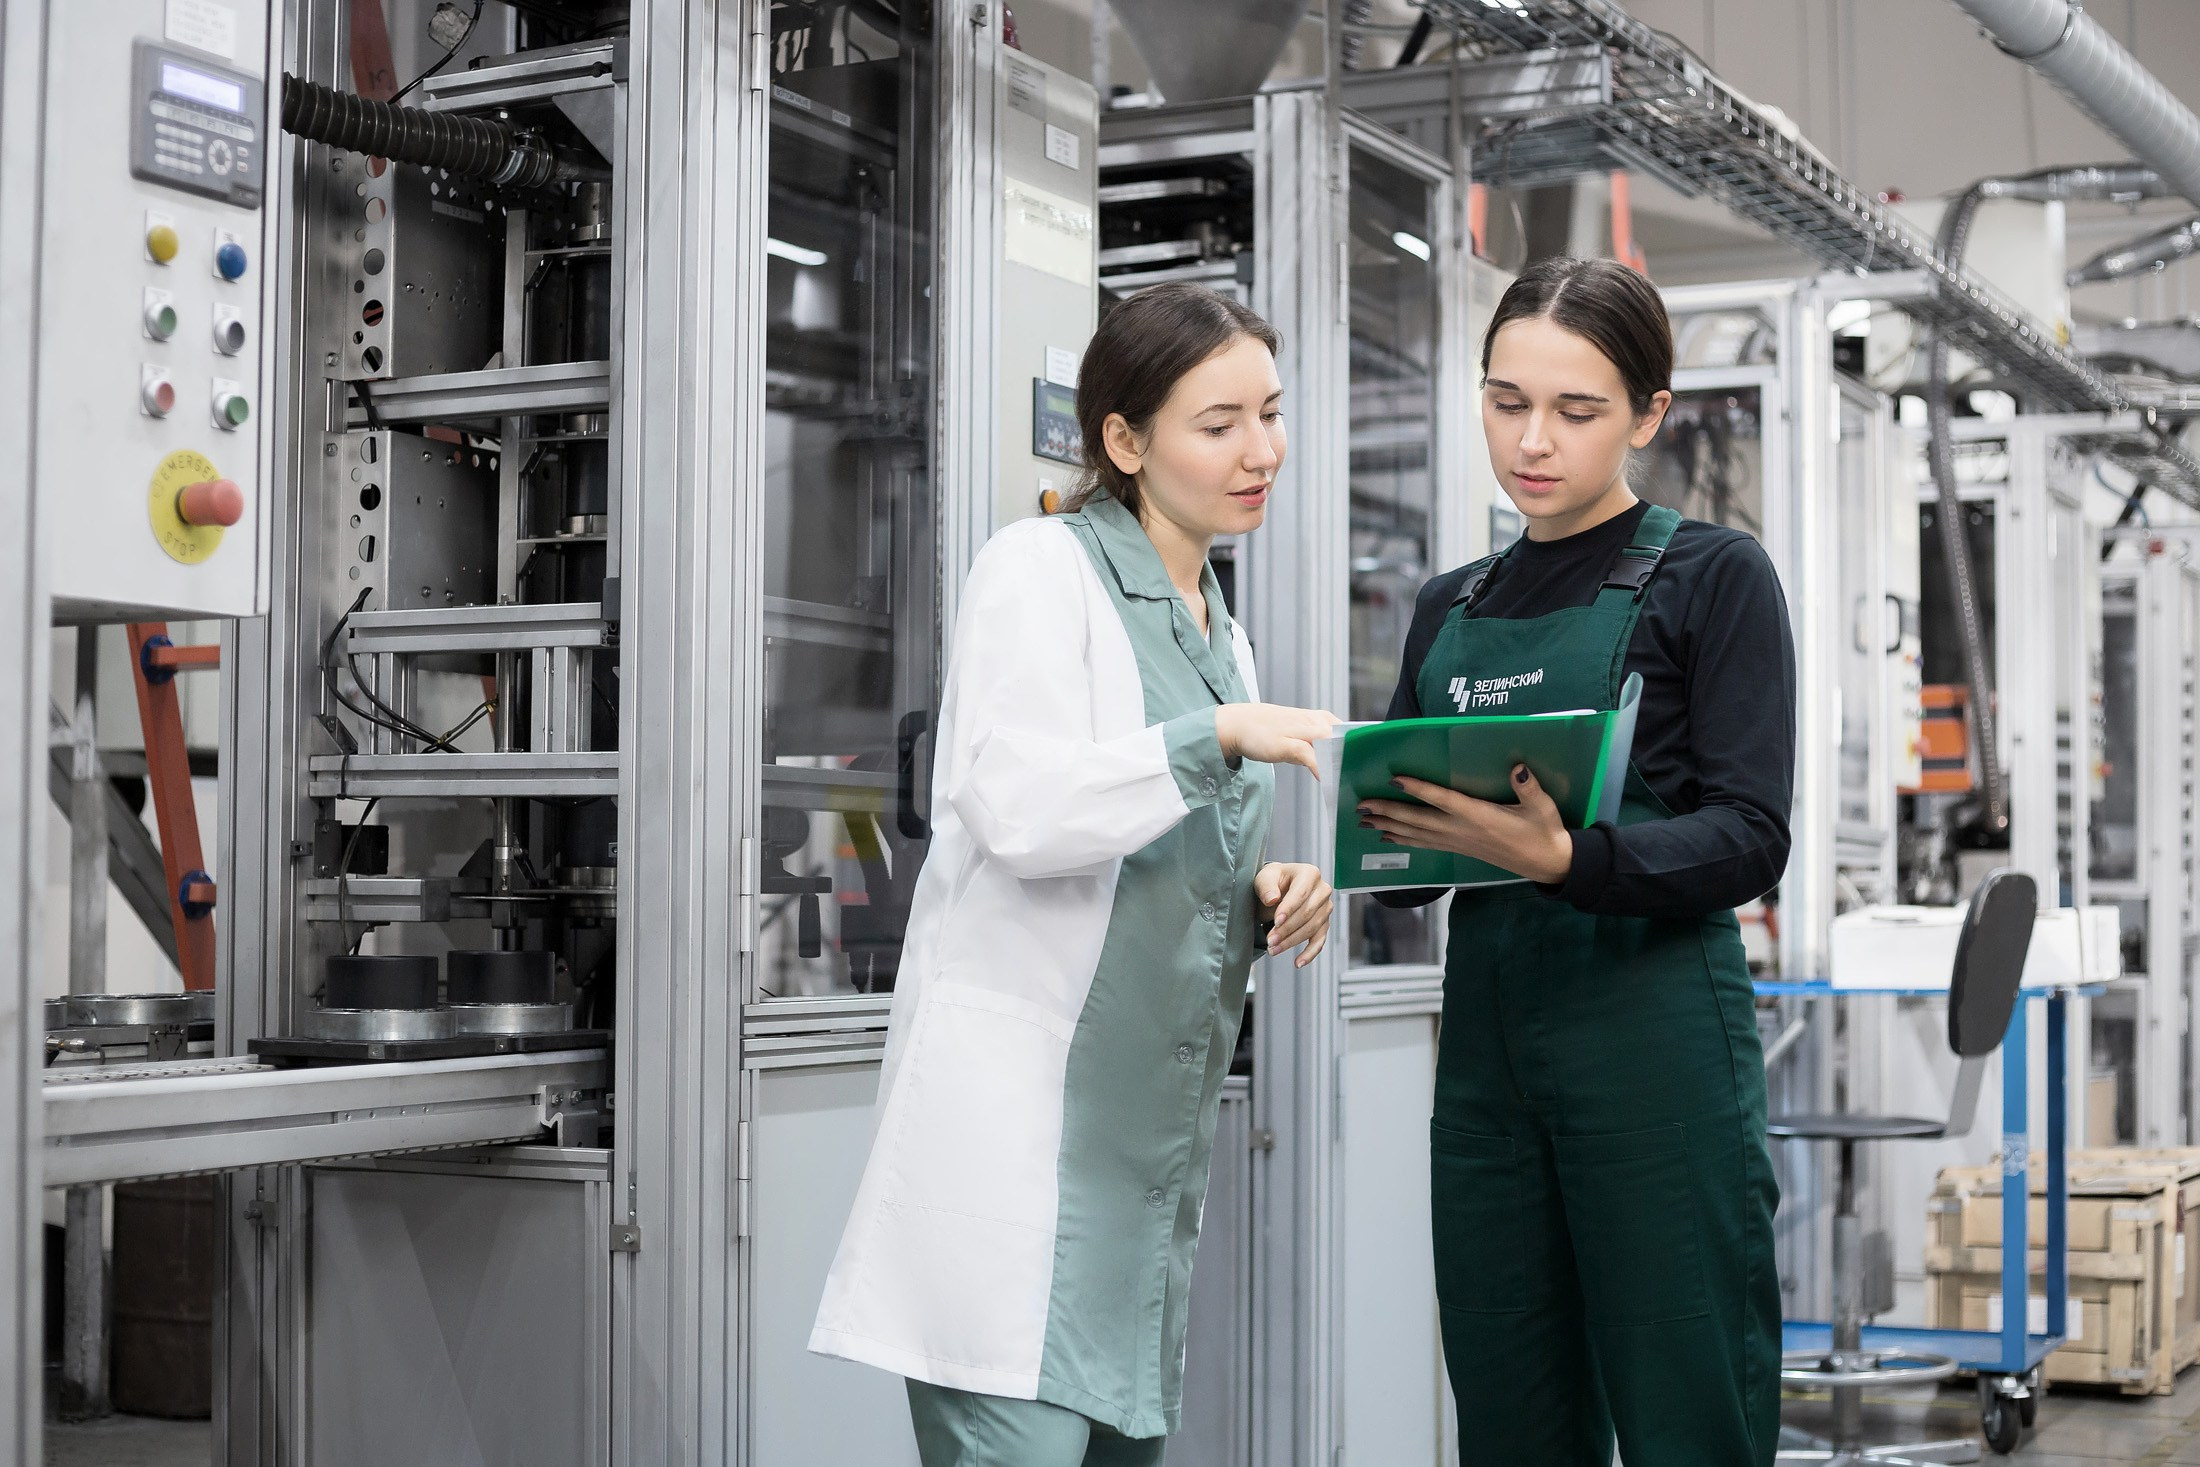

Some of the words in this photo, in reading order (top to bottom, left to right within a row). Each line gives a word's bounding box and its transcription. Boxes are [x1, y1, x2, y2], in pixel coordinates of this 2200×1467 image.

[163, 531, 196, 557] STOP
[1473, 667, 1544, 692] ЗЕЛИНСКИЙ
[1471, 691, 1509, 708] ГРУПП
